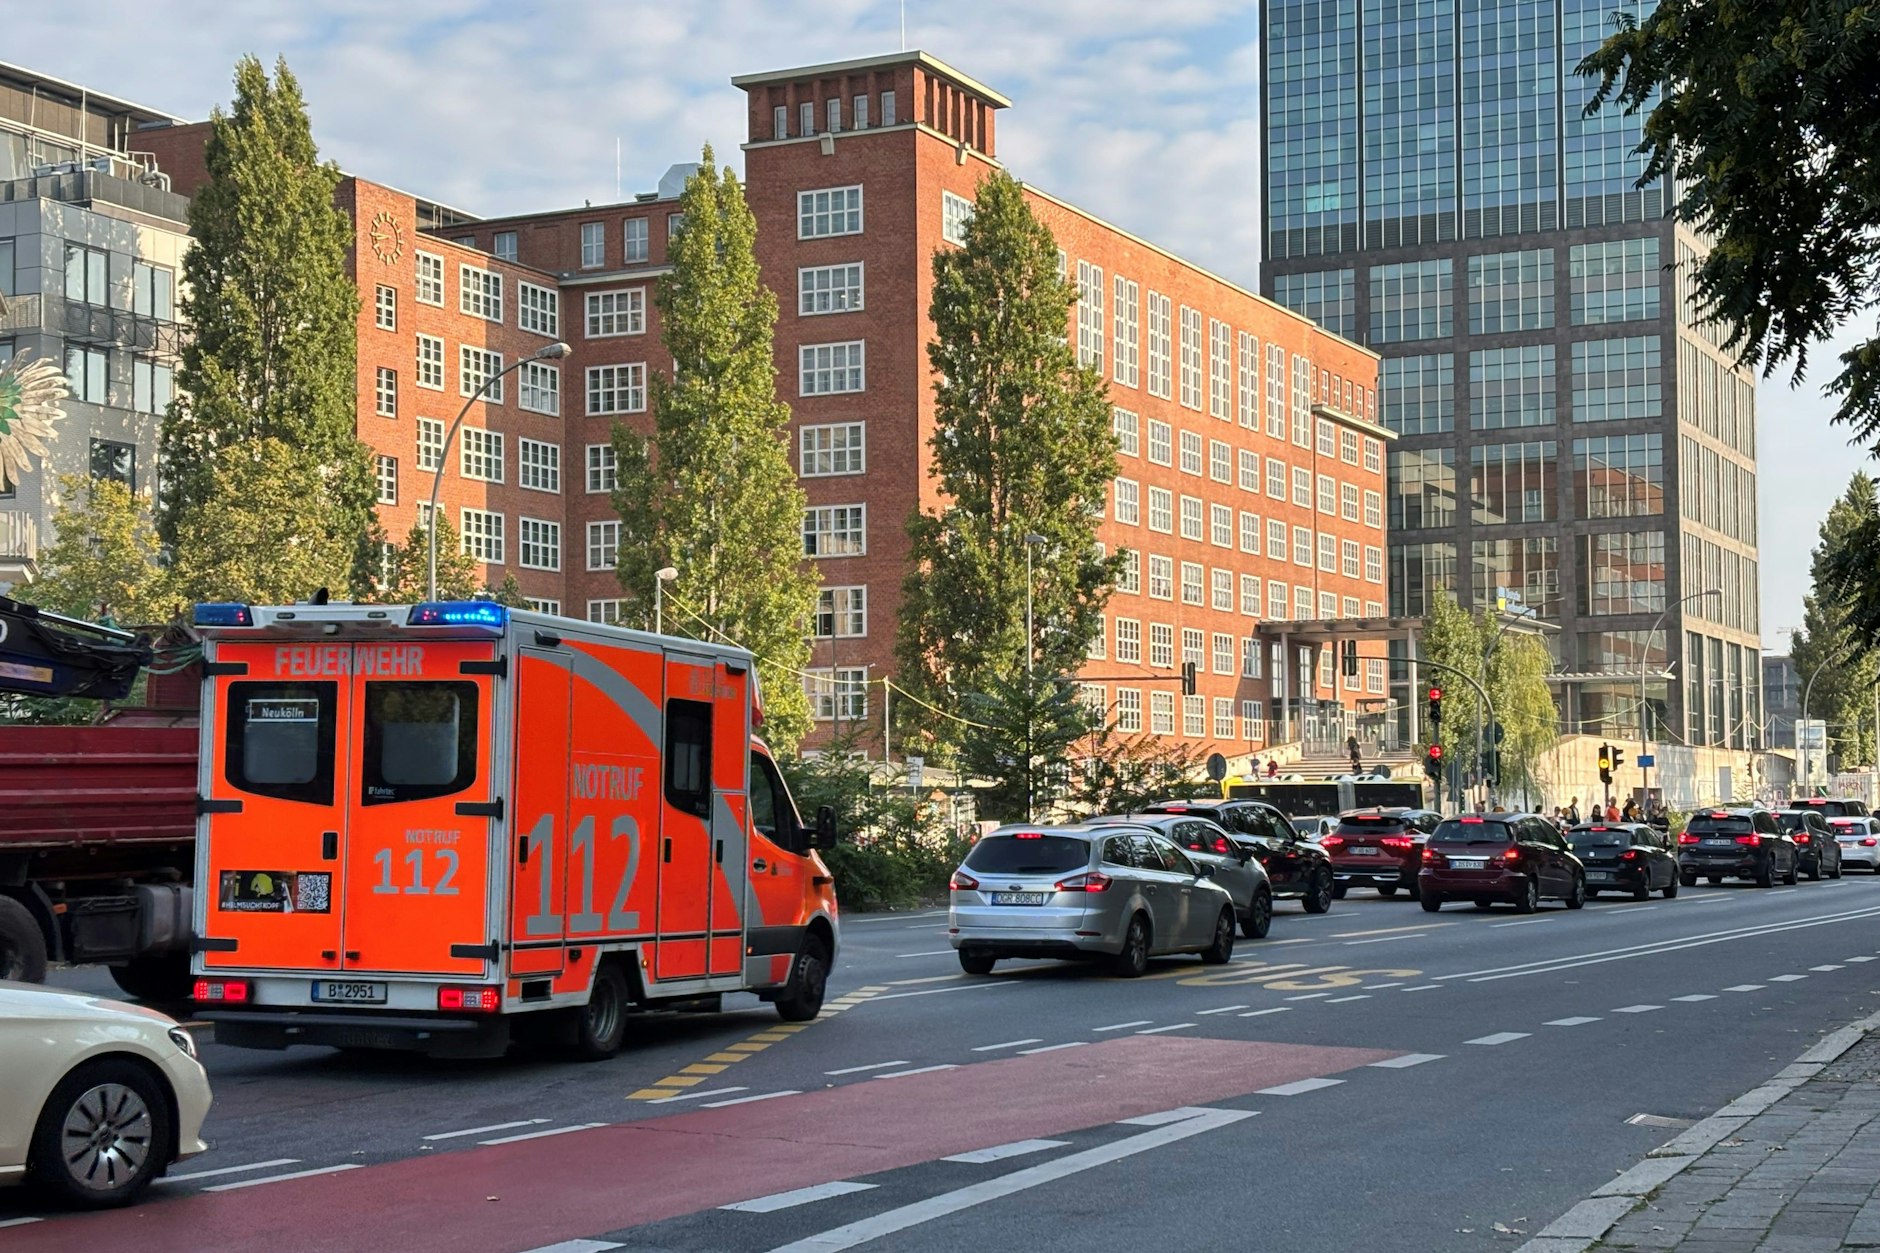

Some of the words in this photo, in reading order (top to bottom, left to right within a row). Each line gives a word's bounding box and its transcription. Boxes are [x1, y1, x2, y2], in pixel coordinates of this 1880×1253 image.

[275, 646, 424, 676] FEUERWEHR
[262, 707, 304, 719] Neukölln
[573, 763, 644, 800] NOTRUF
[406, 829, 461, 844] NOTRUF
[372, 847, 460, 895] 112
[526, 813, 640, 935] 112
[328, 984, 337, 998] B
[344, 984, 375, 999] 2951
